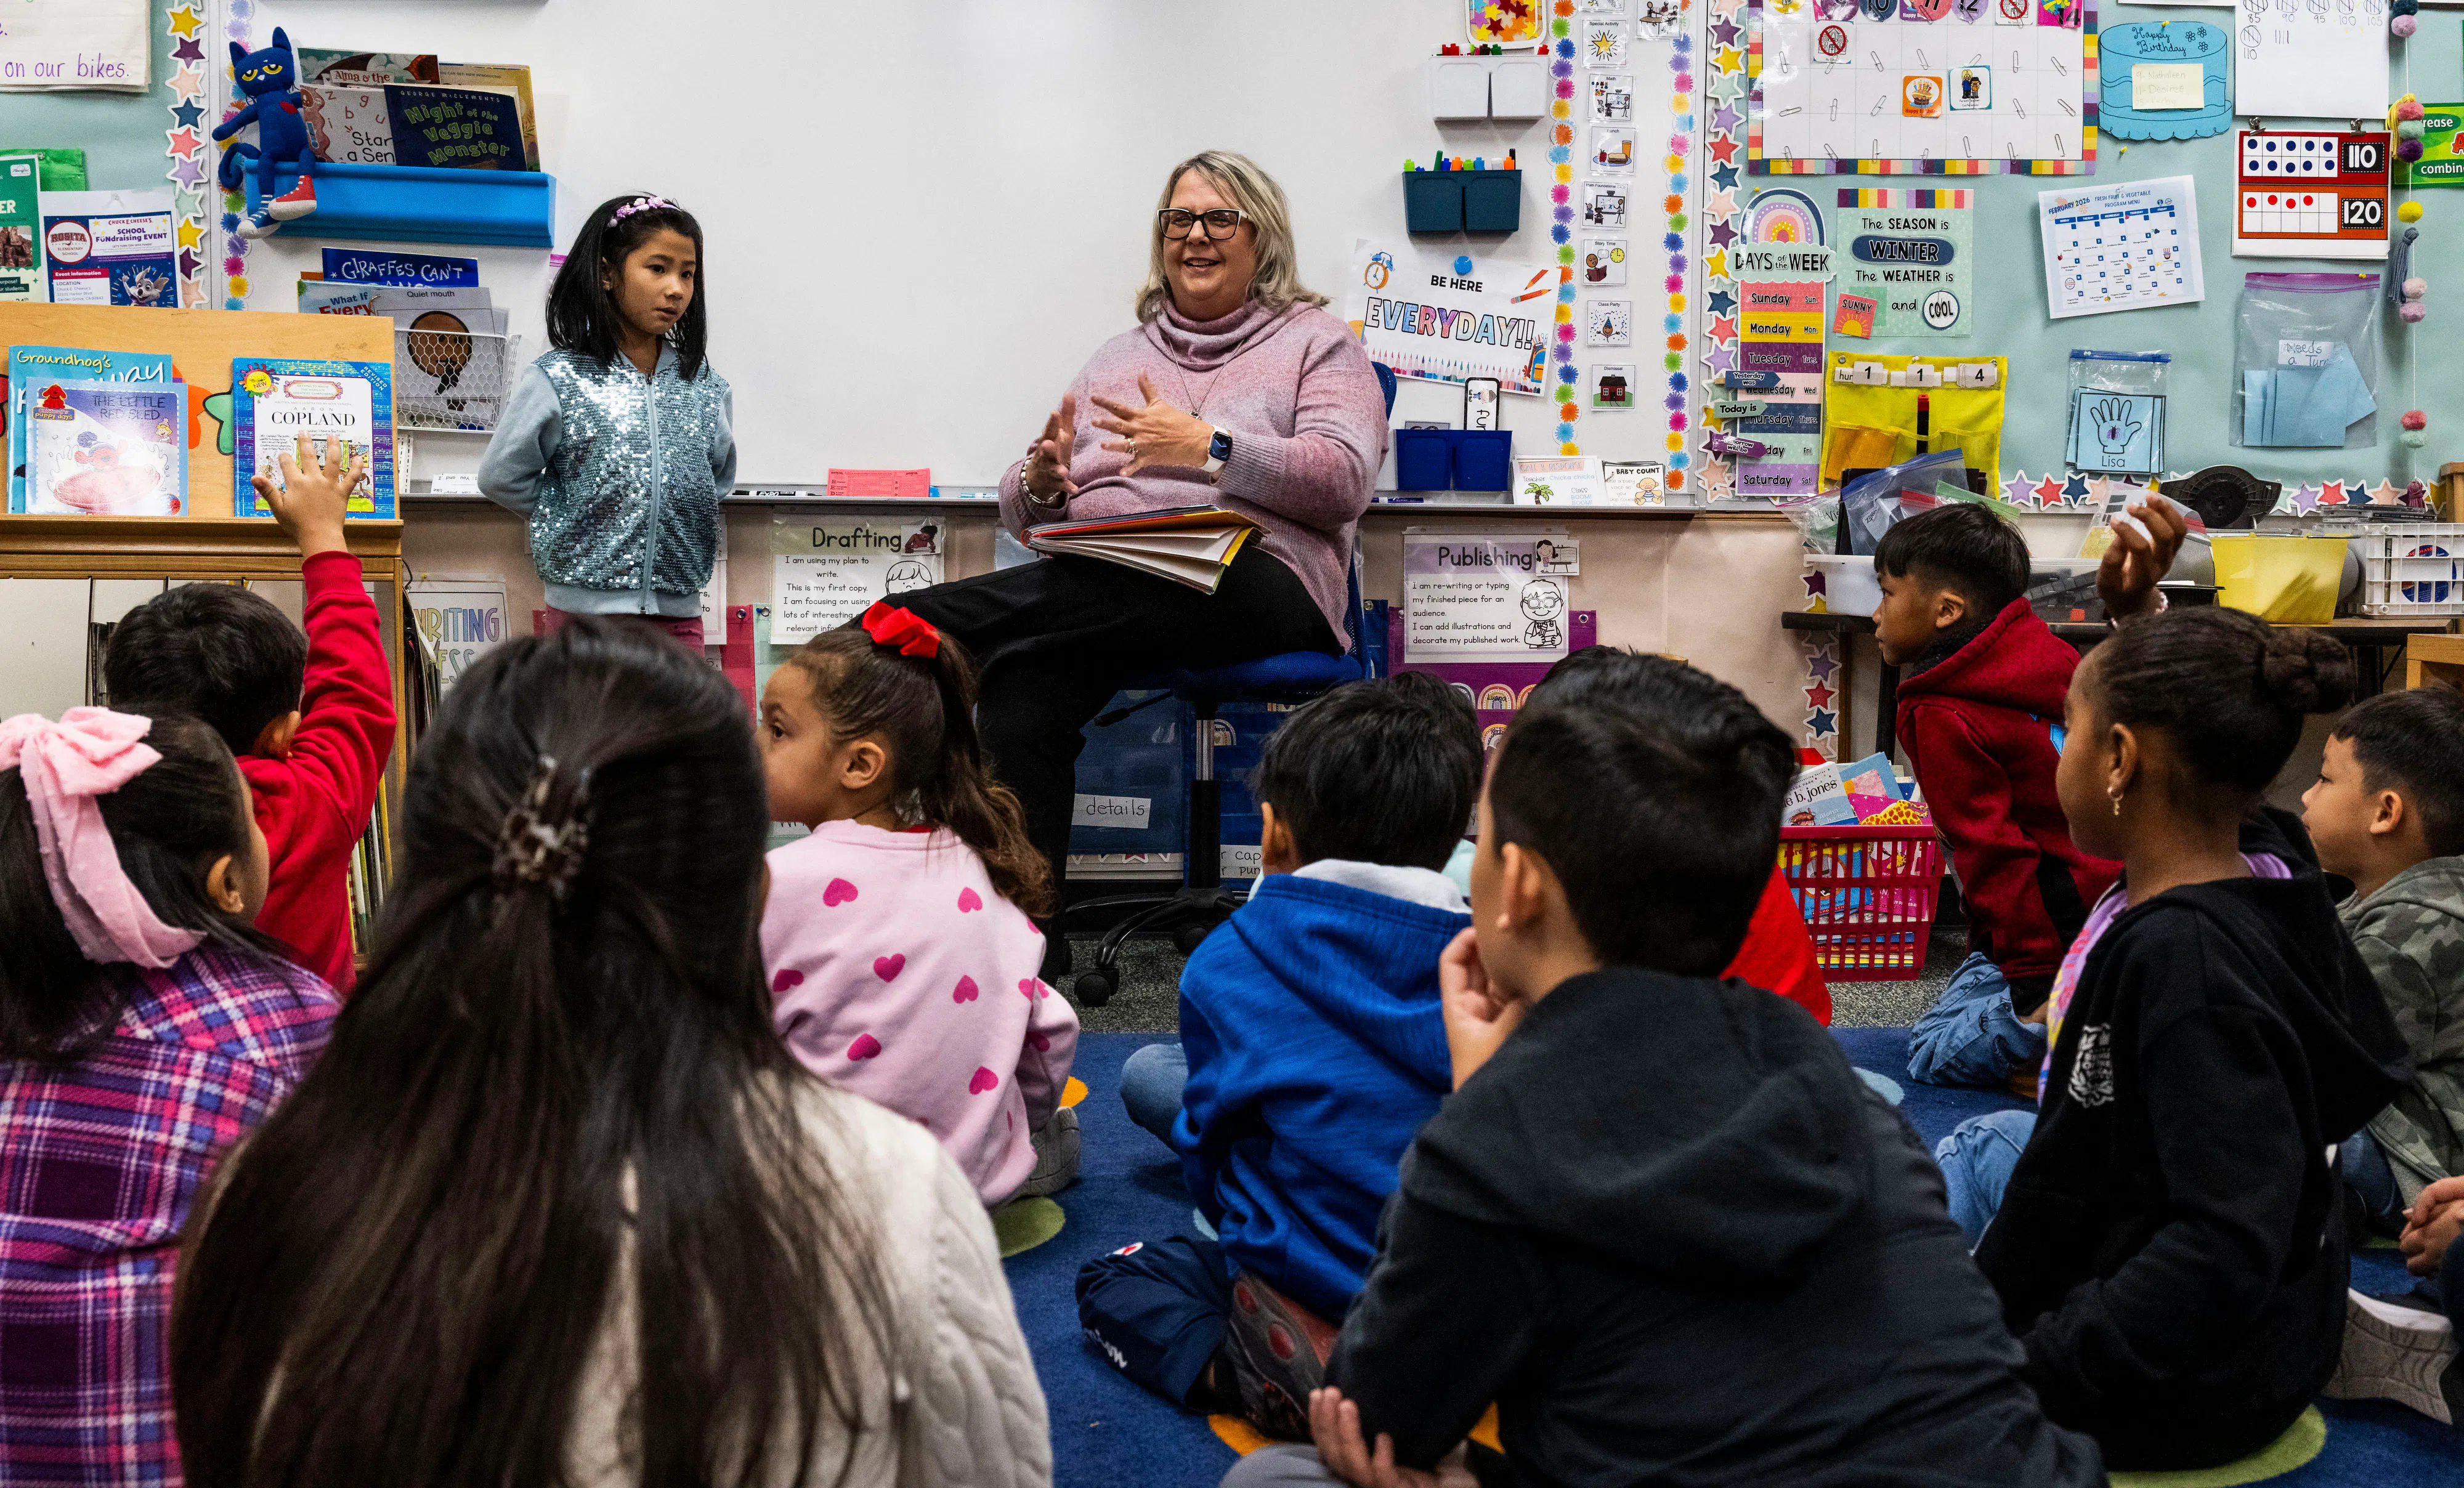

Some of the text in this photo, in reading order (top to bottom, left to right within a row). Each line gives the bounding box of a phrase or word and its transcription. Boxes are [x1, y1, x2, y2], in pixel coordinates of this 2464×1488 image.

[2248, 14, 2383, 26] 85 90 95 100 105
[2132, 27, 2170, 43] Happy
[2137, 40, 2186, 57] Birthday
[2243, 47, 2257, 60] 110
[5, 53, 129, 78] on our bikes.
[335, 71, 390, 83] Alma & the
[404, 102, 498, 124] Night of the
[423, 121, 493, 142] Veggie
[428, 141, 510, 166] Monster
[2349, 145, 2377, 168] 110
[2048, 201, 2074, 215] FEBRUARY
[2075, 197, 2090, 208] 2026
[2344, 201, 2381, 224] 120
[1862, 218, 1949, 230] The SEASON is
[51, 232, 87, 241] ROSITA
[144, 232, 167, 240] EVENT
[1869, 240, 1939, 261] WINTER
[1735, 253, 1772, 270] DAYS
[1789, 253, 1830, 272] WEEK
[341, 258, 462, 281] GIRAFFES CAN'T
[1855, 270, 1954, 282] The WEATHER is
[1430, 275, 1483, 293] BE HERE
[330, 292, 368, 306] What If
[1751, 293, 1791, 305] Sunday
[1842, 299, 1917, 313] SUNNY and
[1929, 301, 1953, 318] COOL
[1365, 296, 1535, 350] EVERYDAY!!
[1750, 323, 1791, 336] Monday
[2287, 341, 2322, 354] Needs
[17, 350, 111, 373] Groundhog's
[1749, 353, 1791, 366] Tuesday
[360, 369, 384, 391] EDITION
[363, 366, 387, 388] REVISED
[1865, 366, 1985, 381] 1 1 4
[1745, 386, 1795, 398] Wednesday
[1720, 403, 1757, 414] Today is
[272, 411, 355, 426] COPLAND
[1745, 414, 1794, 426] Thursday
[2101, 456, 2126, 468] Lisa
[1744, 474, 1792, 488] Saturday
[813, 527, 901, 552] Drafting
[807, 557, 826, 565] using
[843, 557, 858, 565] plan
[1438, 546, 1533, 571] Publishing
[787, 583, 802, 591] This
[829, 583, 846, 591] first
[849, 585, 868, 593] copy.
[1433, 581, 1472, 591] re-writing
[1486, 582, 1509, 591] typing
[805, 597, 837, 607] focusing
[851, 599, 870, 607] using
[1412, 597, 1424, 605] my
[1427, 594, 1456, 603] finished
[1459, 596, 1478, 605] piece
[813, 612, 853, 620] interesting
[1452, 622, 1495, 630] illustrations
[1464, 636, 1497, 645] published
[1807, 780, 1837, 802] jones
[1087, 797, 1145, 816] details
